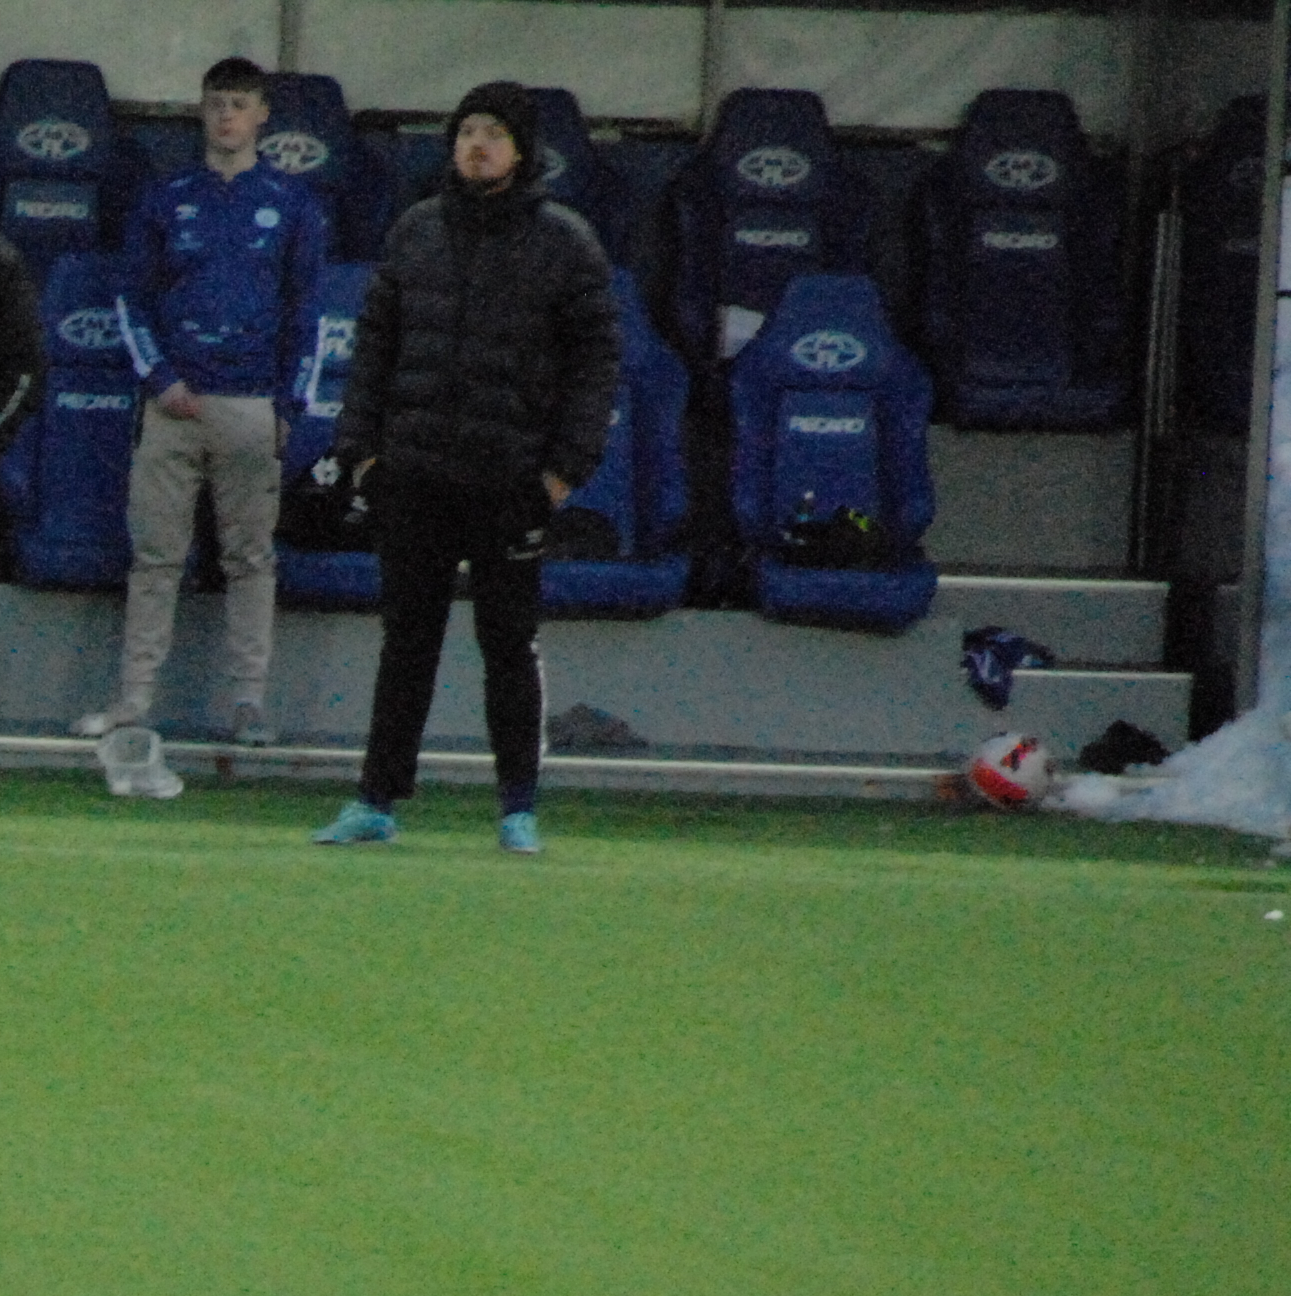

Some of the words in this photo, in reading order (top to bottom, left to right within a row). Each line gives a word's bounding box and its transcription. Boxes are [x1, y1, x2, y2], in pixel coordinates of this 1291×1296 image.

[16, 201, 89, 218] RECARO
[735, 230, 810, 246] RECARO
[983, 232, 1058, 249] RECARO
[57, 392, 133, 409] RECARO
[790, 416, 865, 433] RECARO
